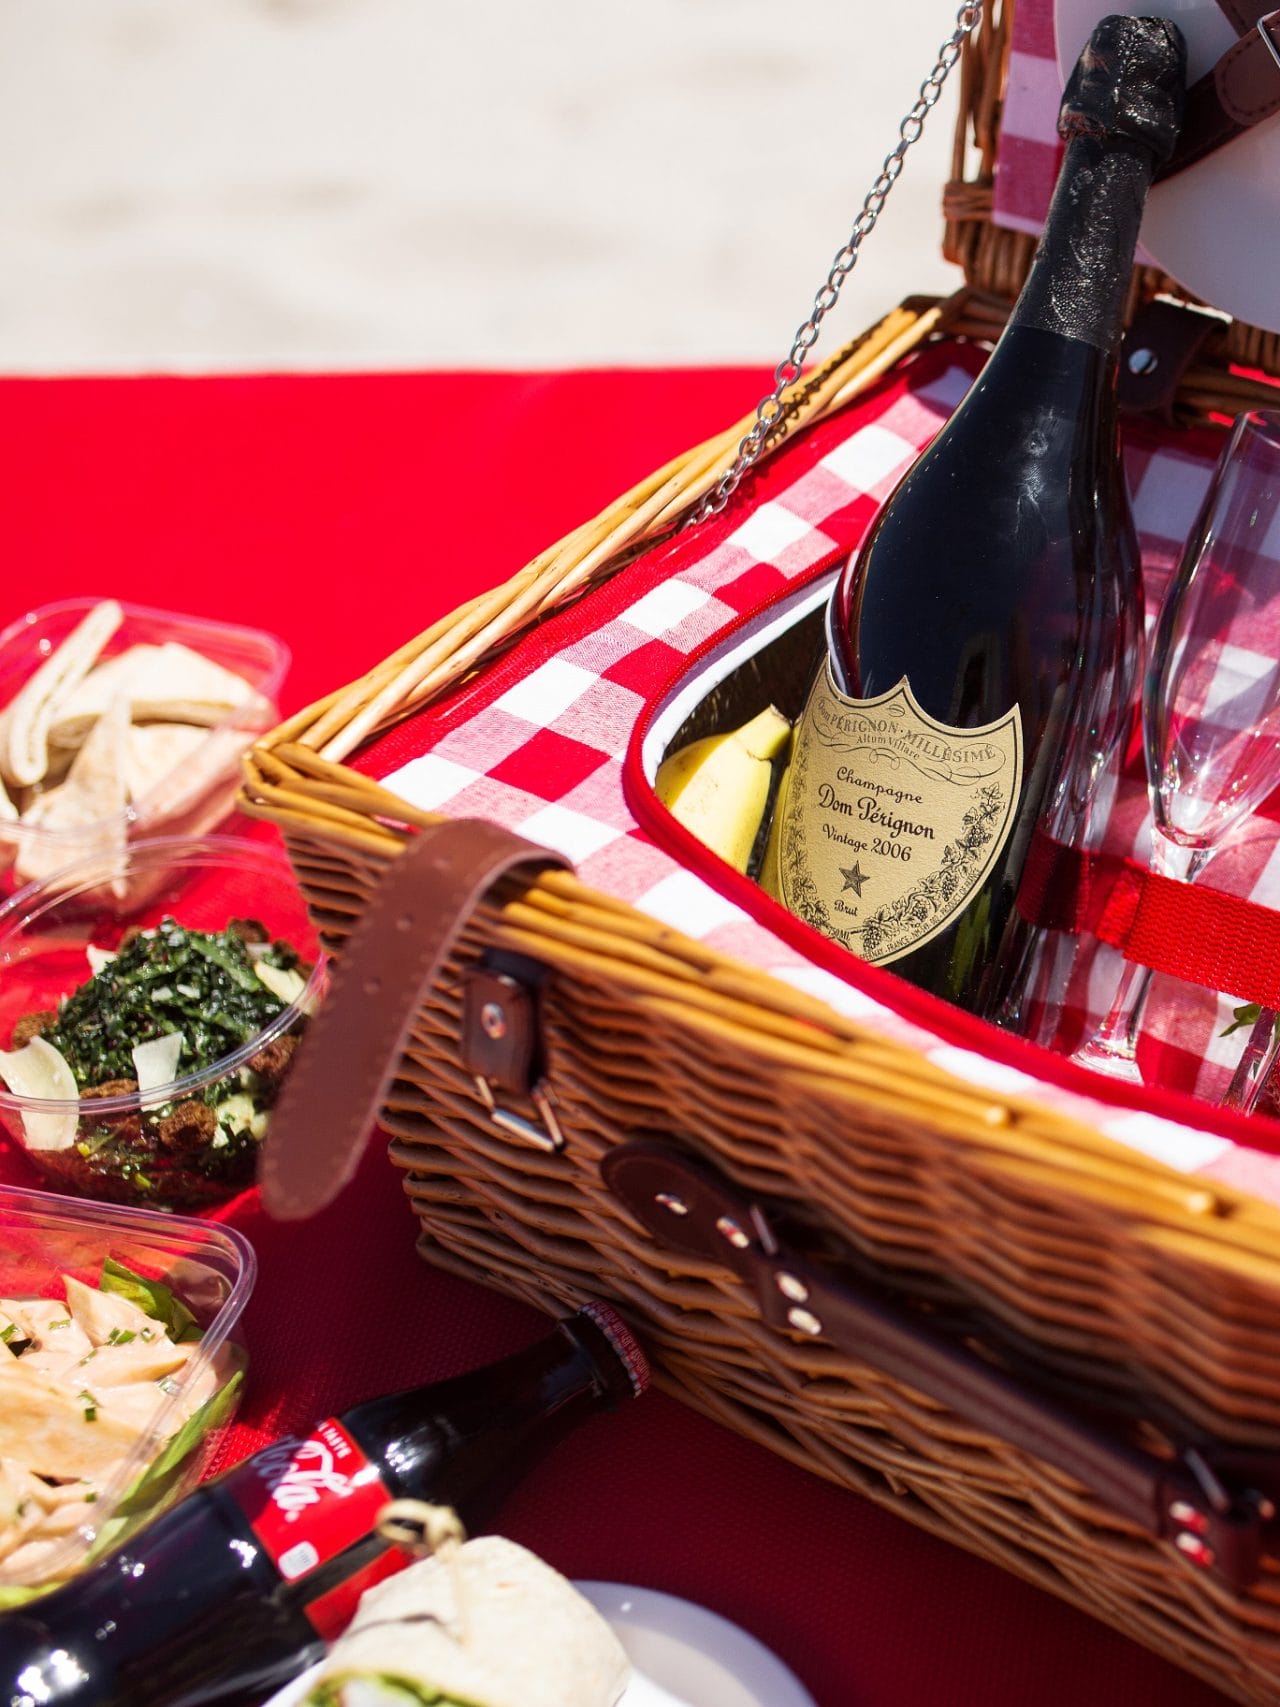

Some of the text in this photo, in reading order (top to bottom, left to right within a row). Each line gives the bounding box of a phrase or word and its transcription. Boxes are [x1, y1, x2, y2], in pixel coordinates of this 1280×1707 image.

[856, 733, 887, 746] Altum
[836, 766, 924, 804] Champagne
[818, 783, 936, 840] Dom Pérignon
[822, 823, 913, 862] Vintage 2006
[834, 899, 858, 917] Brut
